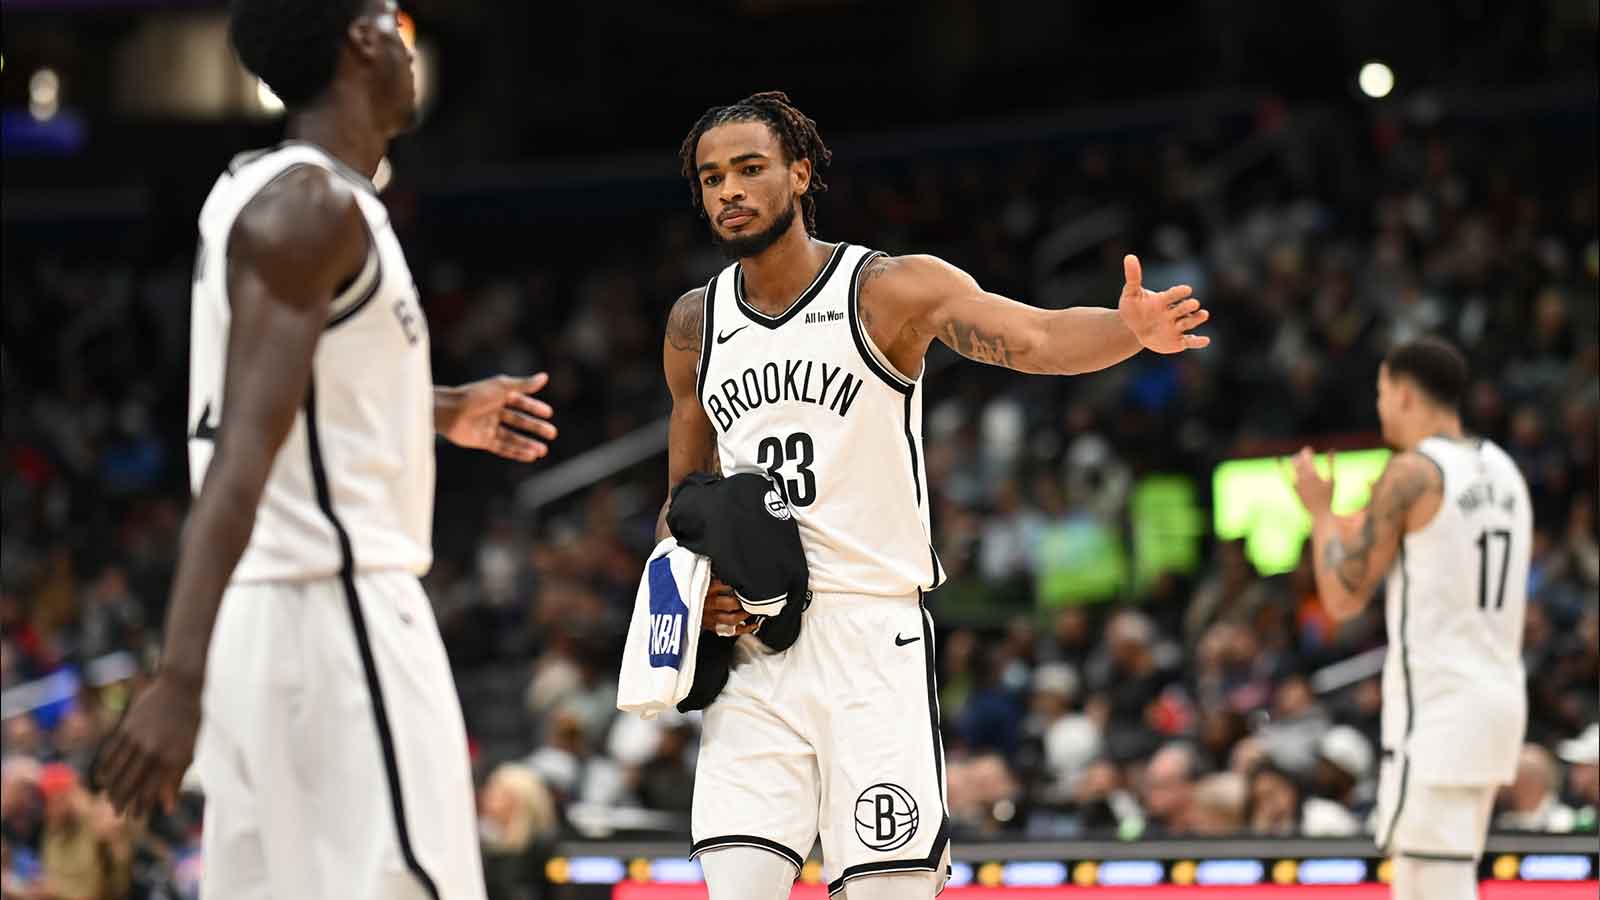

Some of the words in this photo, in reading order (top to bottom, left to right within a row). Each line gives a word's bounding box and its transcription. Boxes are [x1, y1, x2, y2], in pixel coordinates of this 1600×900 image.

[805, 312, 816, 324] All
[817, 311, 826, 322] In
[826, 310, 844, 321] Won
[708, 360, 863, 432] BROOKLYN
[757, 432, 817, 507] 33
[1475, 528, 1512, 611] 17
[650, 613, 683, 655] NBA
[876, 794, 896, 840] B
